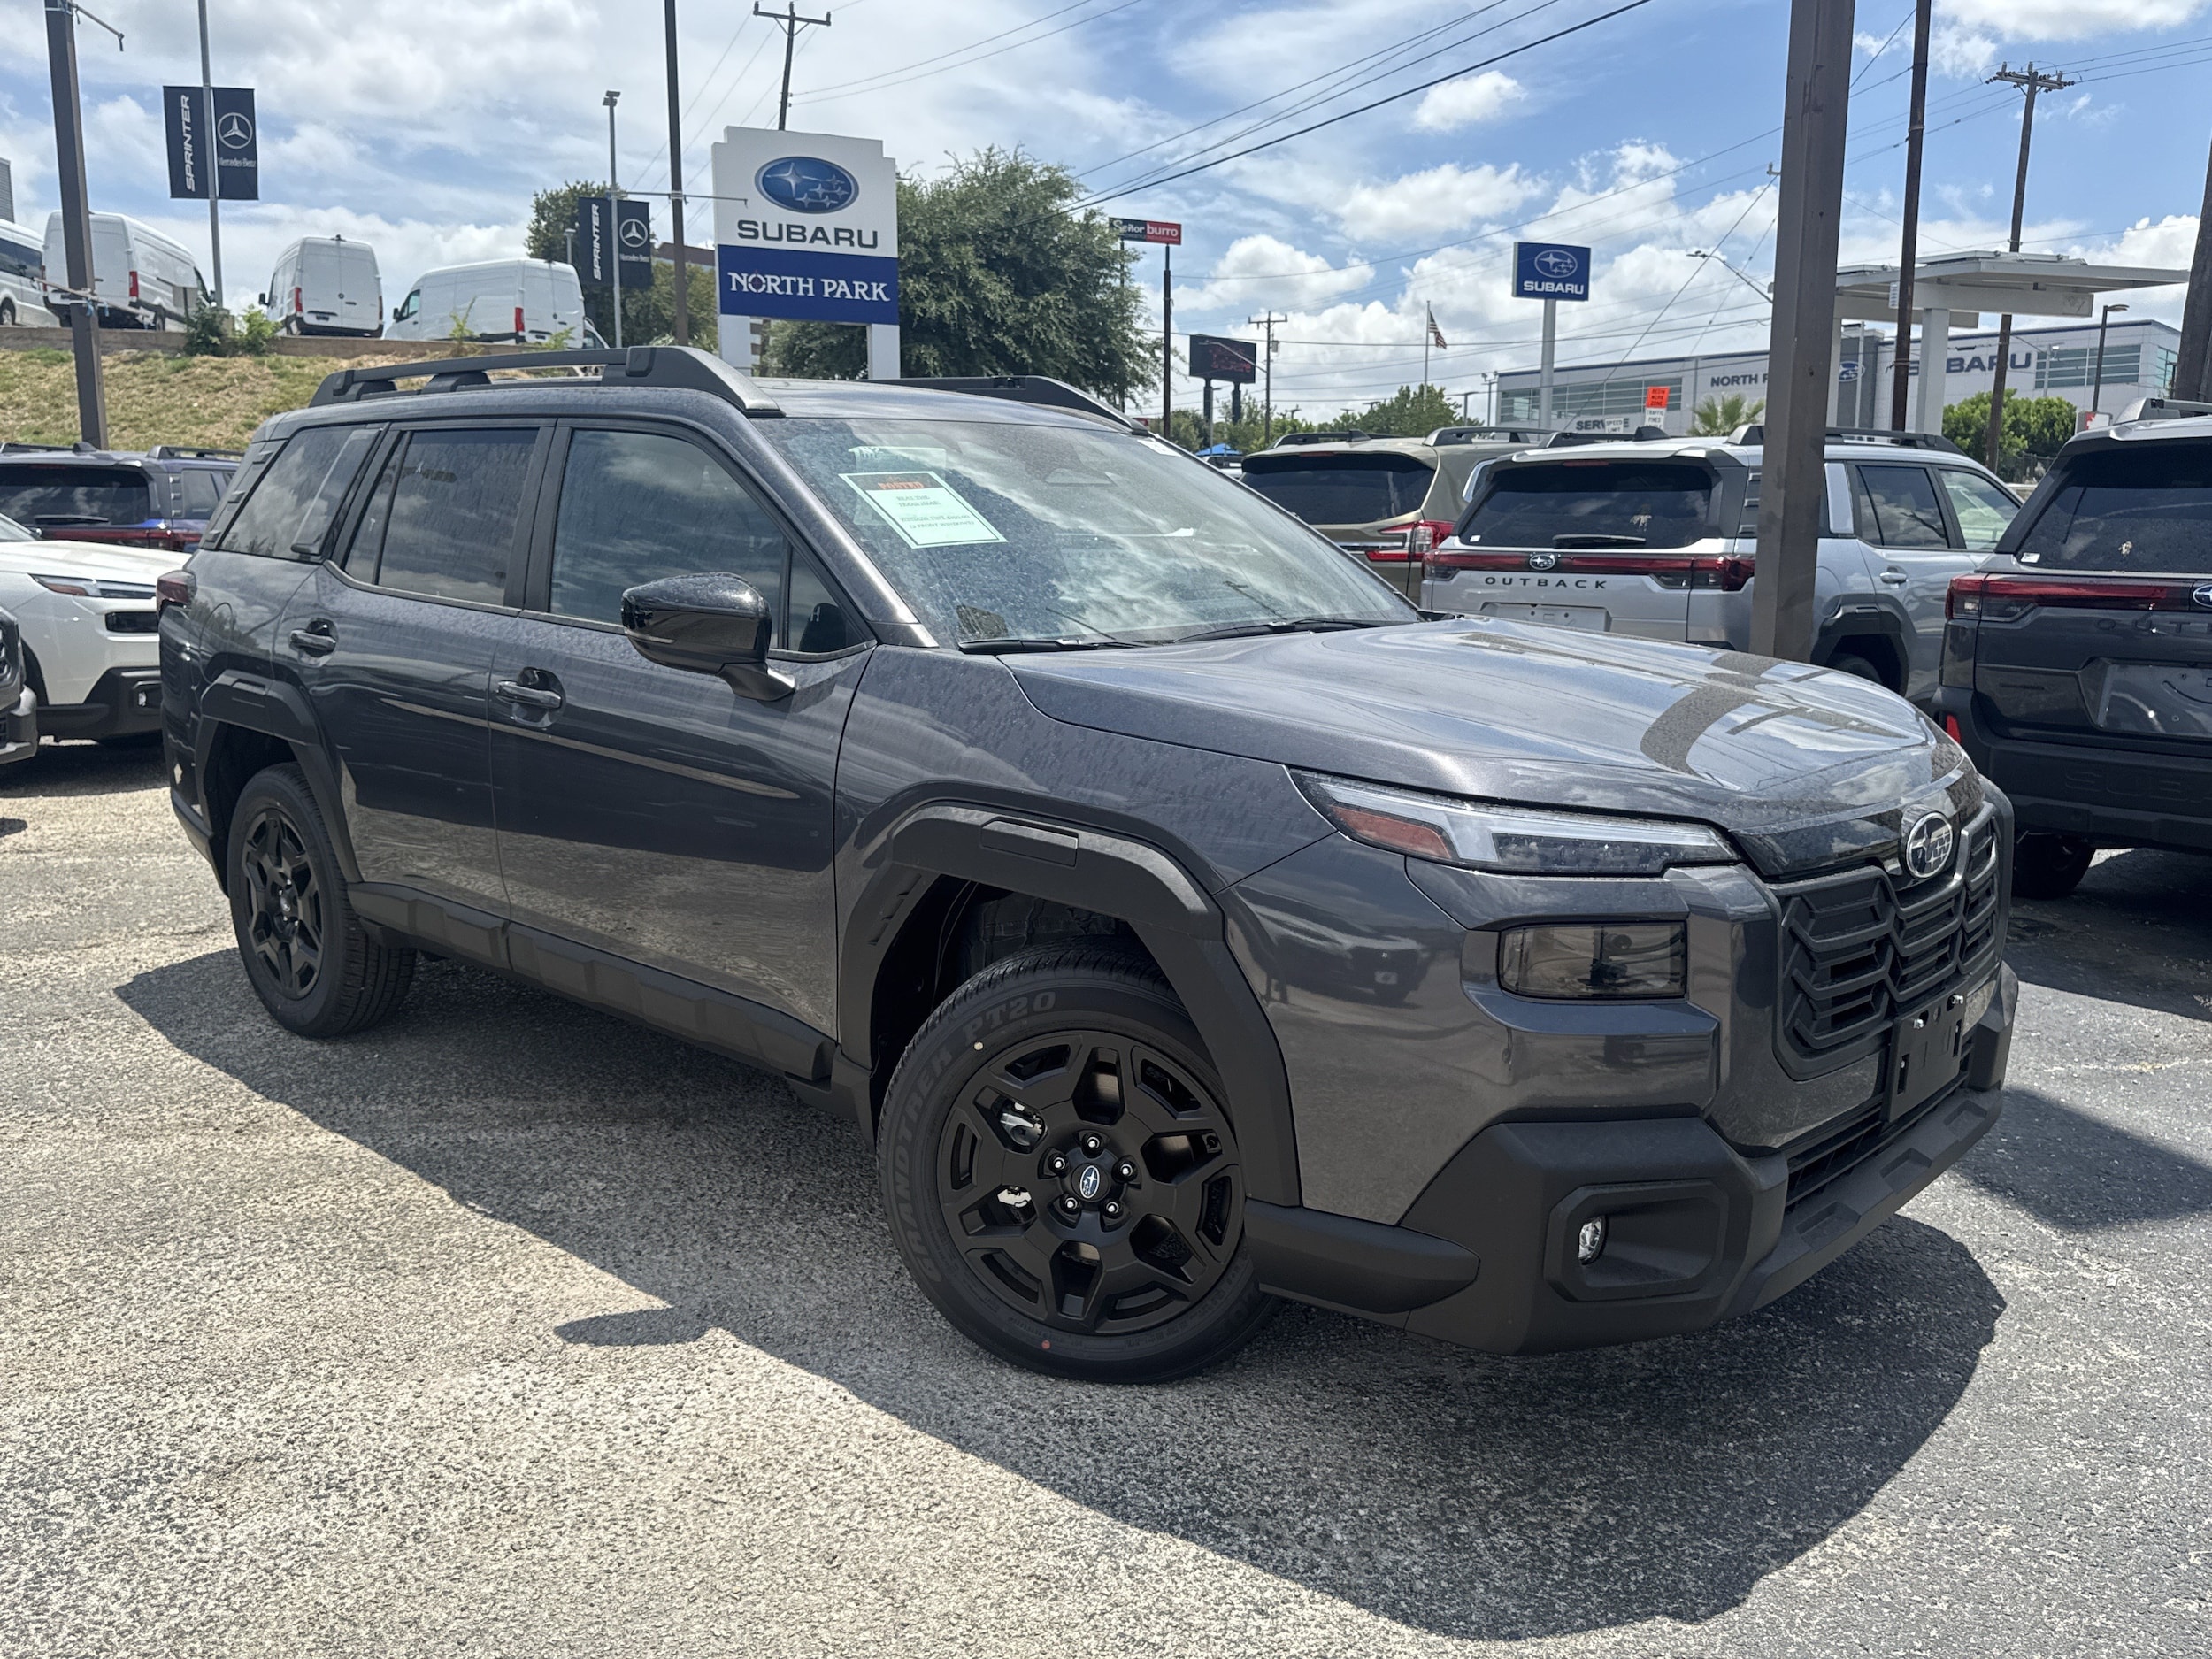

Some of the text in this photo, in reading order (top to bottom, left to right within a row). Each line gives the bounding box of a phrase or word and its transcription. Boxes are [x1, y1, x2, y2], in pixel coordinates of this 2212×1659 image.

[180, 94, 195, 192] SPRINTER
[737, 219, 879, 250] SUBARU
[1112, 219, 1145, 234] Señor
[1146, 223, 1179, 237] burro
[591, 204, 602, 280] SPRINTER
[727, 272, 891, 302] NORTH PARK
[1523, 280, 1585, 295] SUBARU
[1710, 373, 1758, 387] NORTH
[1485, 576, 1608, 589] OUTBACK
[2094, 618, 2212, 635] OUT
[961, 990, 1057, 1046] PT20
